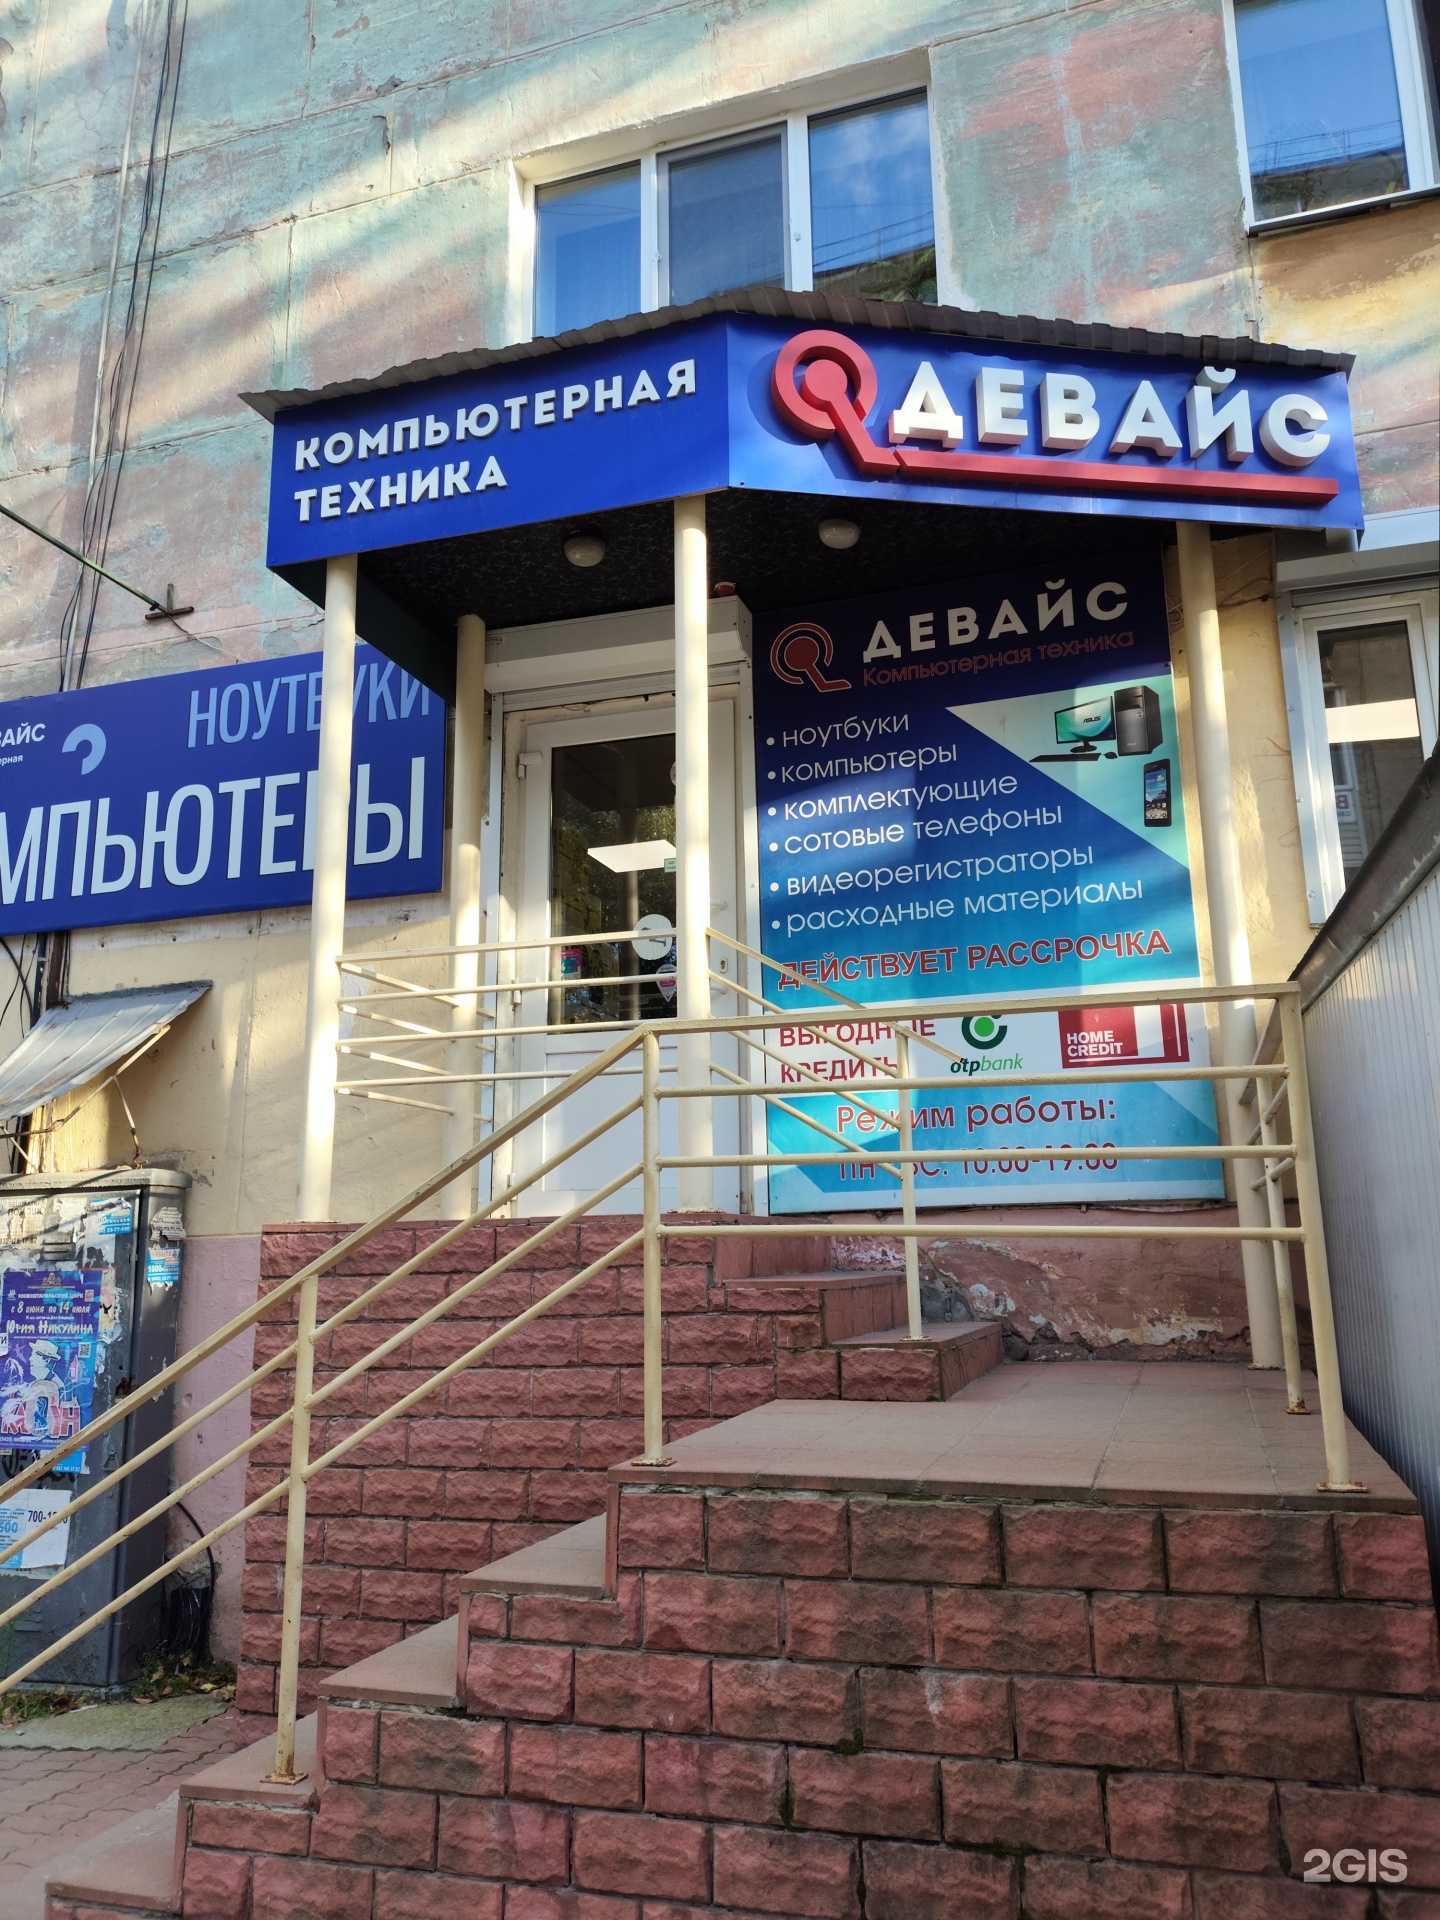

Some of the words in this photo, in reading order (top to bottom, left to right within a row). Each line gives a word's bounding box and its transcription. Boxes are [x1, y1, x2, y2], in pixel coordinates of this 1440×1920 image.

[294, 358, 697, 472] КОМПЬЮТЕРНАЯ
[888, 361, 1331, 468] ДЕВАЙС
[294, 455, 508, 523] ТЕХНИКА
[863, 577, 1128, 664] ДЕВАЙС
[863, 644, 1032, 687] Компьютерная
[1037, 630, 1135, 661] техника
[0, 722, 46, 748] АЙС
[782, 711, 909, 750] ноутбуки
[0, 754, 23, 767] рная
[781, 744, 957, 784] компьютеры
[784, 773, 1018, 821] комплектующие
[0, 756, 425, 905] МПЬЮТЕЫ
[784, 821, 905, 855] сотовые
[913, 804, 1063, 841] телефоны
[786, 843, 1094, 898] видеорегистраторы
[786, 897, 955, 938] расходные
[964, 879, 1143, 921] материалы
[777, 946, 958, 991] ДЕЙСТВУЕТ
[967, 929, 1172, 970] РАССРОЧКА
[1066, 1030, 1115, 1045] HOME
[1067, 1042, 1124, 1057] CREDIT
[967, 1095, 1116, 1134] работы:
